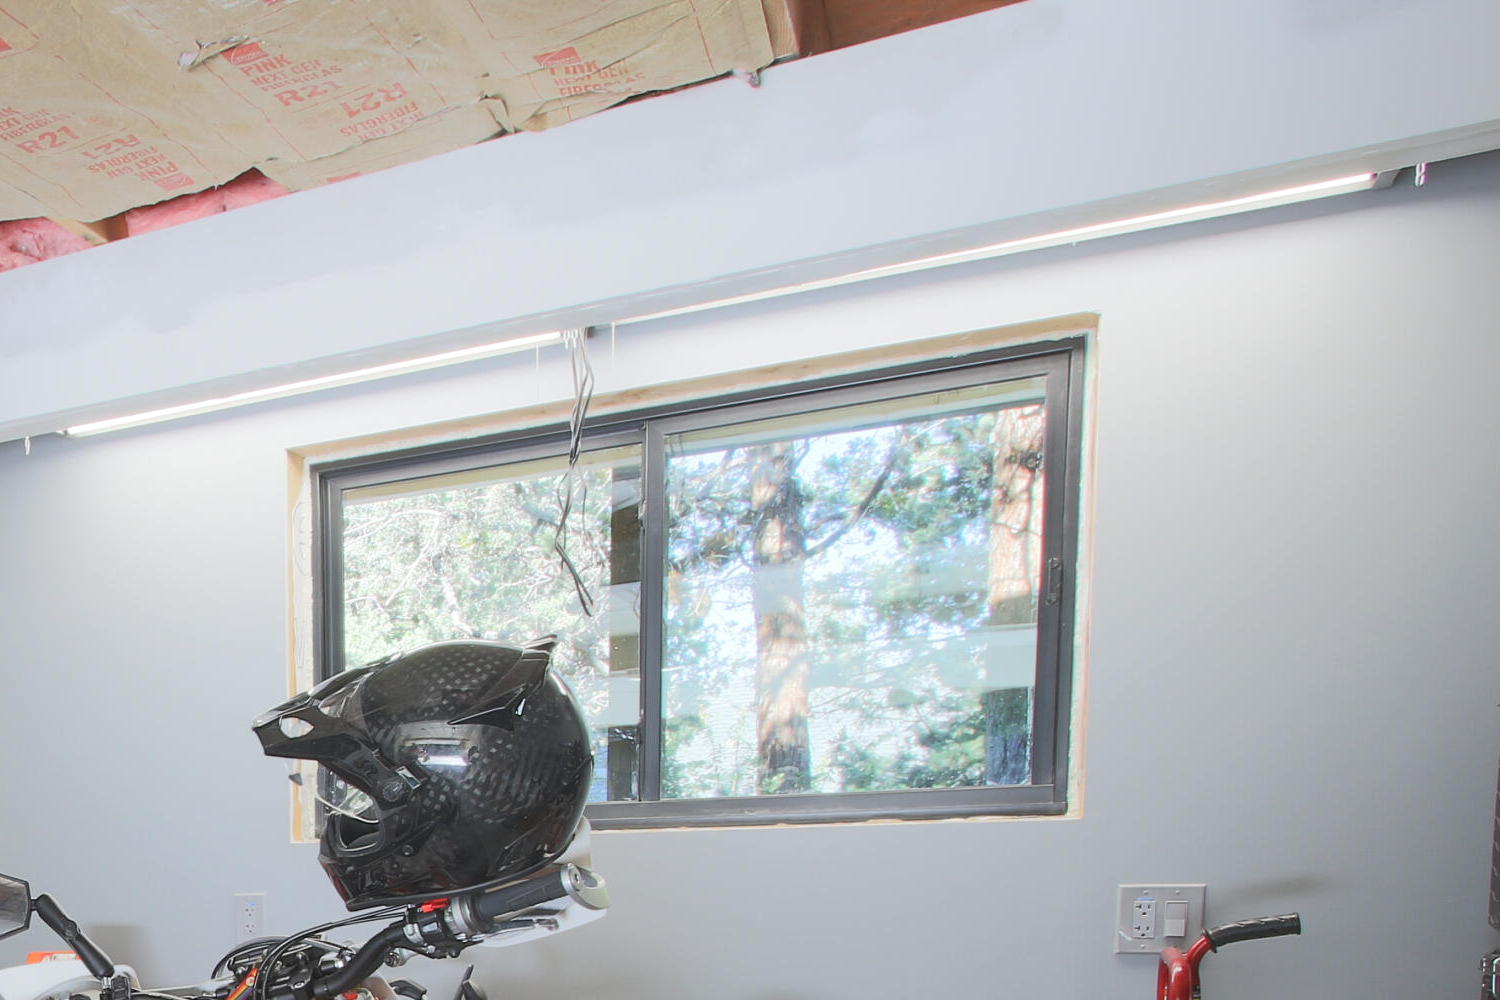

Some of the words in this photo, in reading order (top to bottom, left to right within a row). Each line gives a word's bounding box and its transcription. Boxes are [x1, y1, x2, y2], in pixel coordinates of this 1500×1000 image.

[238, 52, 293, 78] PINK
[250, 69, 290, 88] NEXT
[273, 80, 344, 107] R21
[340, 81, 408, 118] R21
[339, 101, 420, 137] FIBERGLAS
[15, 125, 80, 154] R21
[80, 133, 142, 160] R21
[133, 160, 180, 182] PINK
